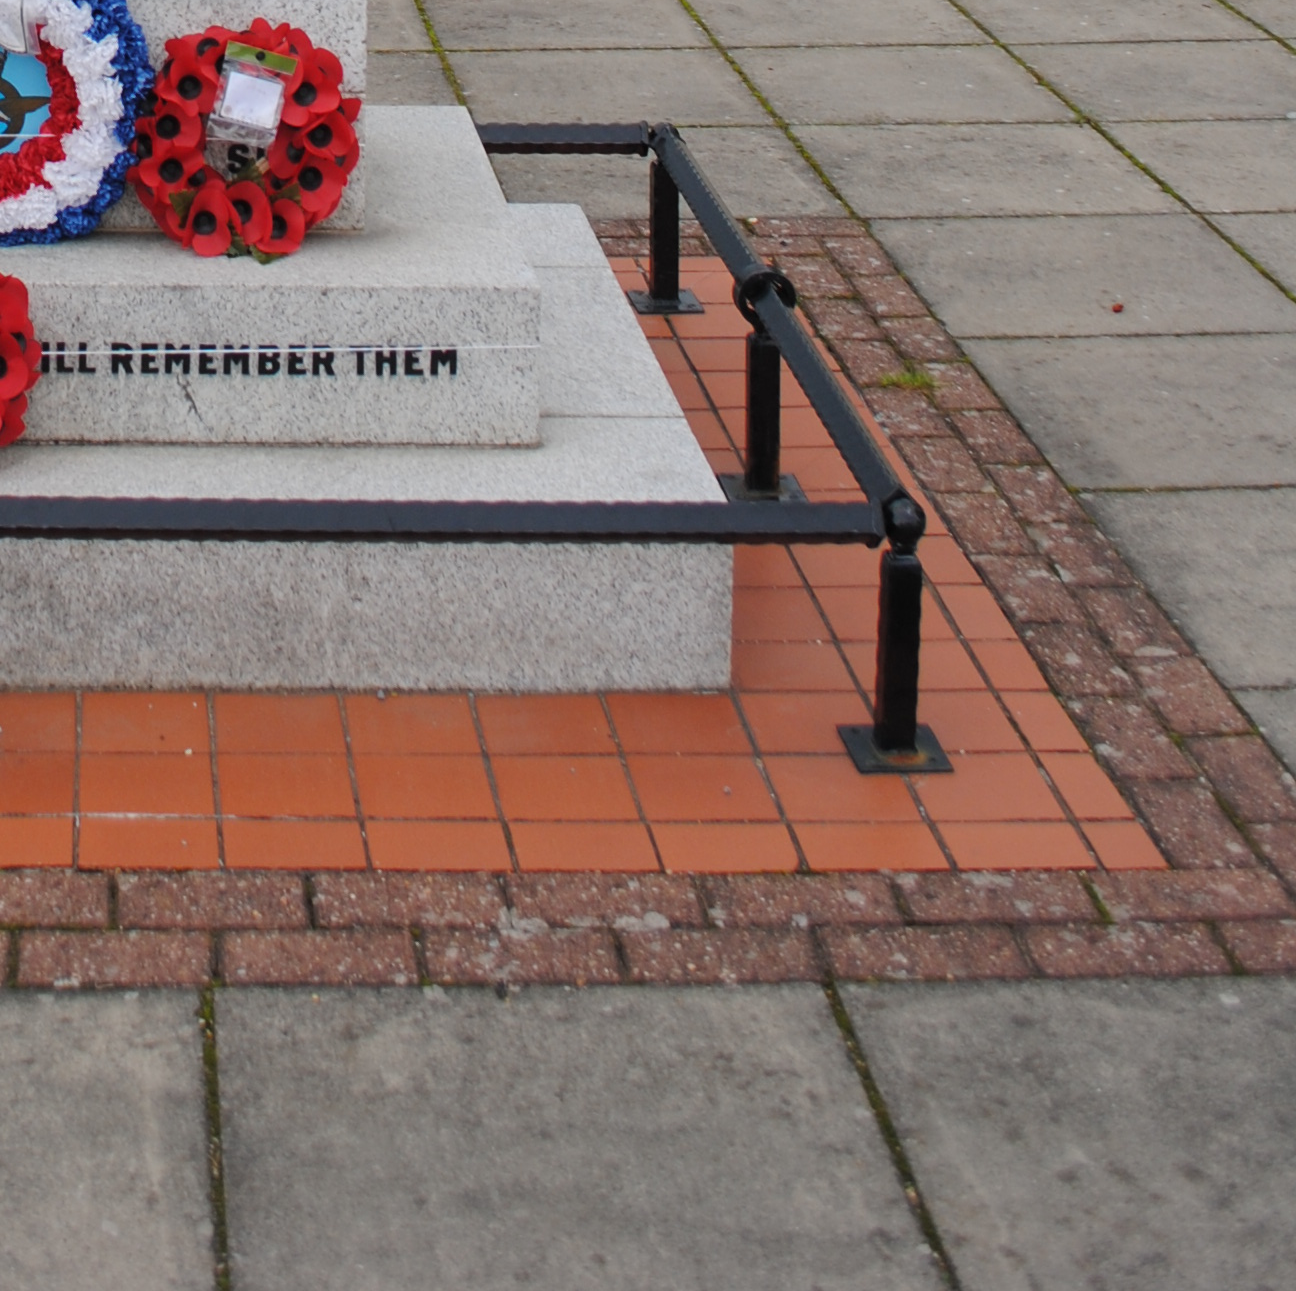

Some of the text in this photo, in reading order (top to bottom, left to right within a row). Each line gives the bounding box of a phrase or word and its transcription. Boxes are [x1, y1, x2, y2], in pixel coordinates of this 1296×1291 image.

[41, 341, 96, 374] ILL
[111, 343, 335, 376] REMEMBER
[351, 344, 458, 376] THEM
